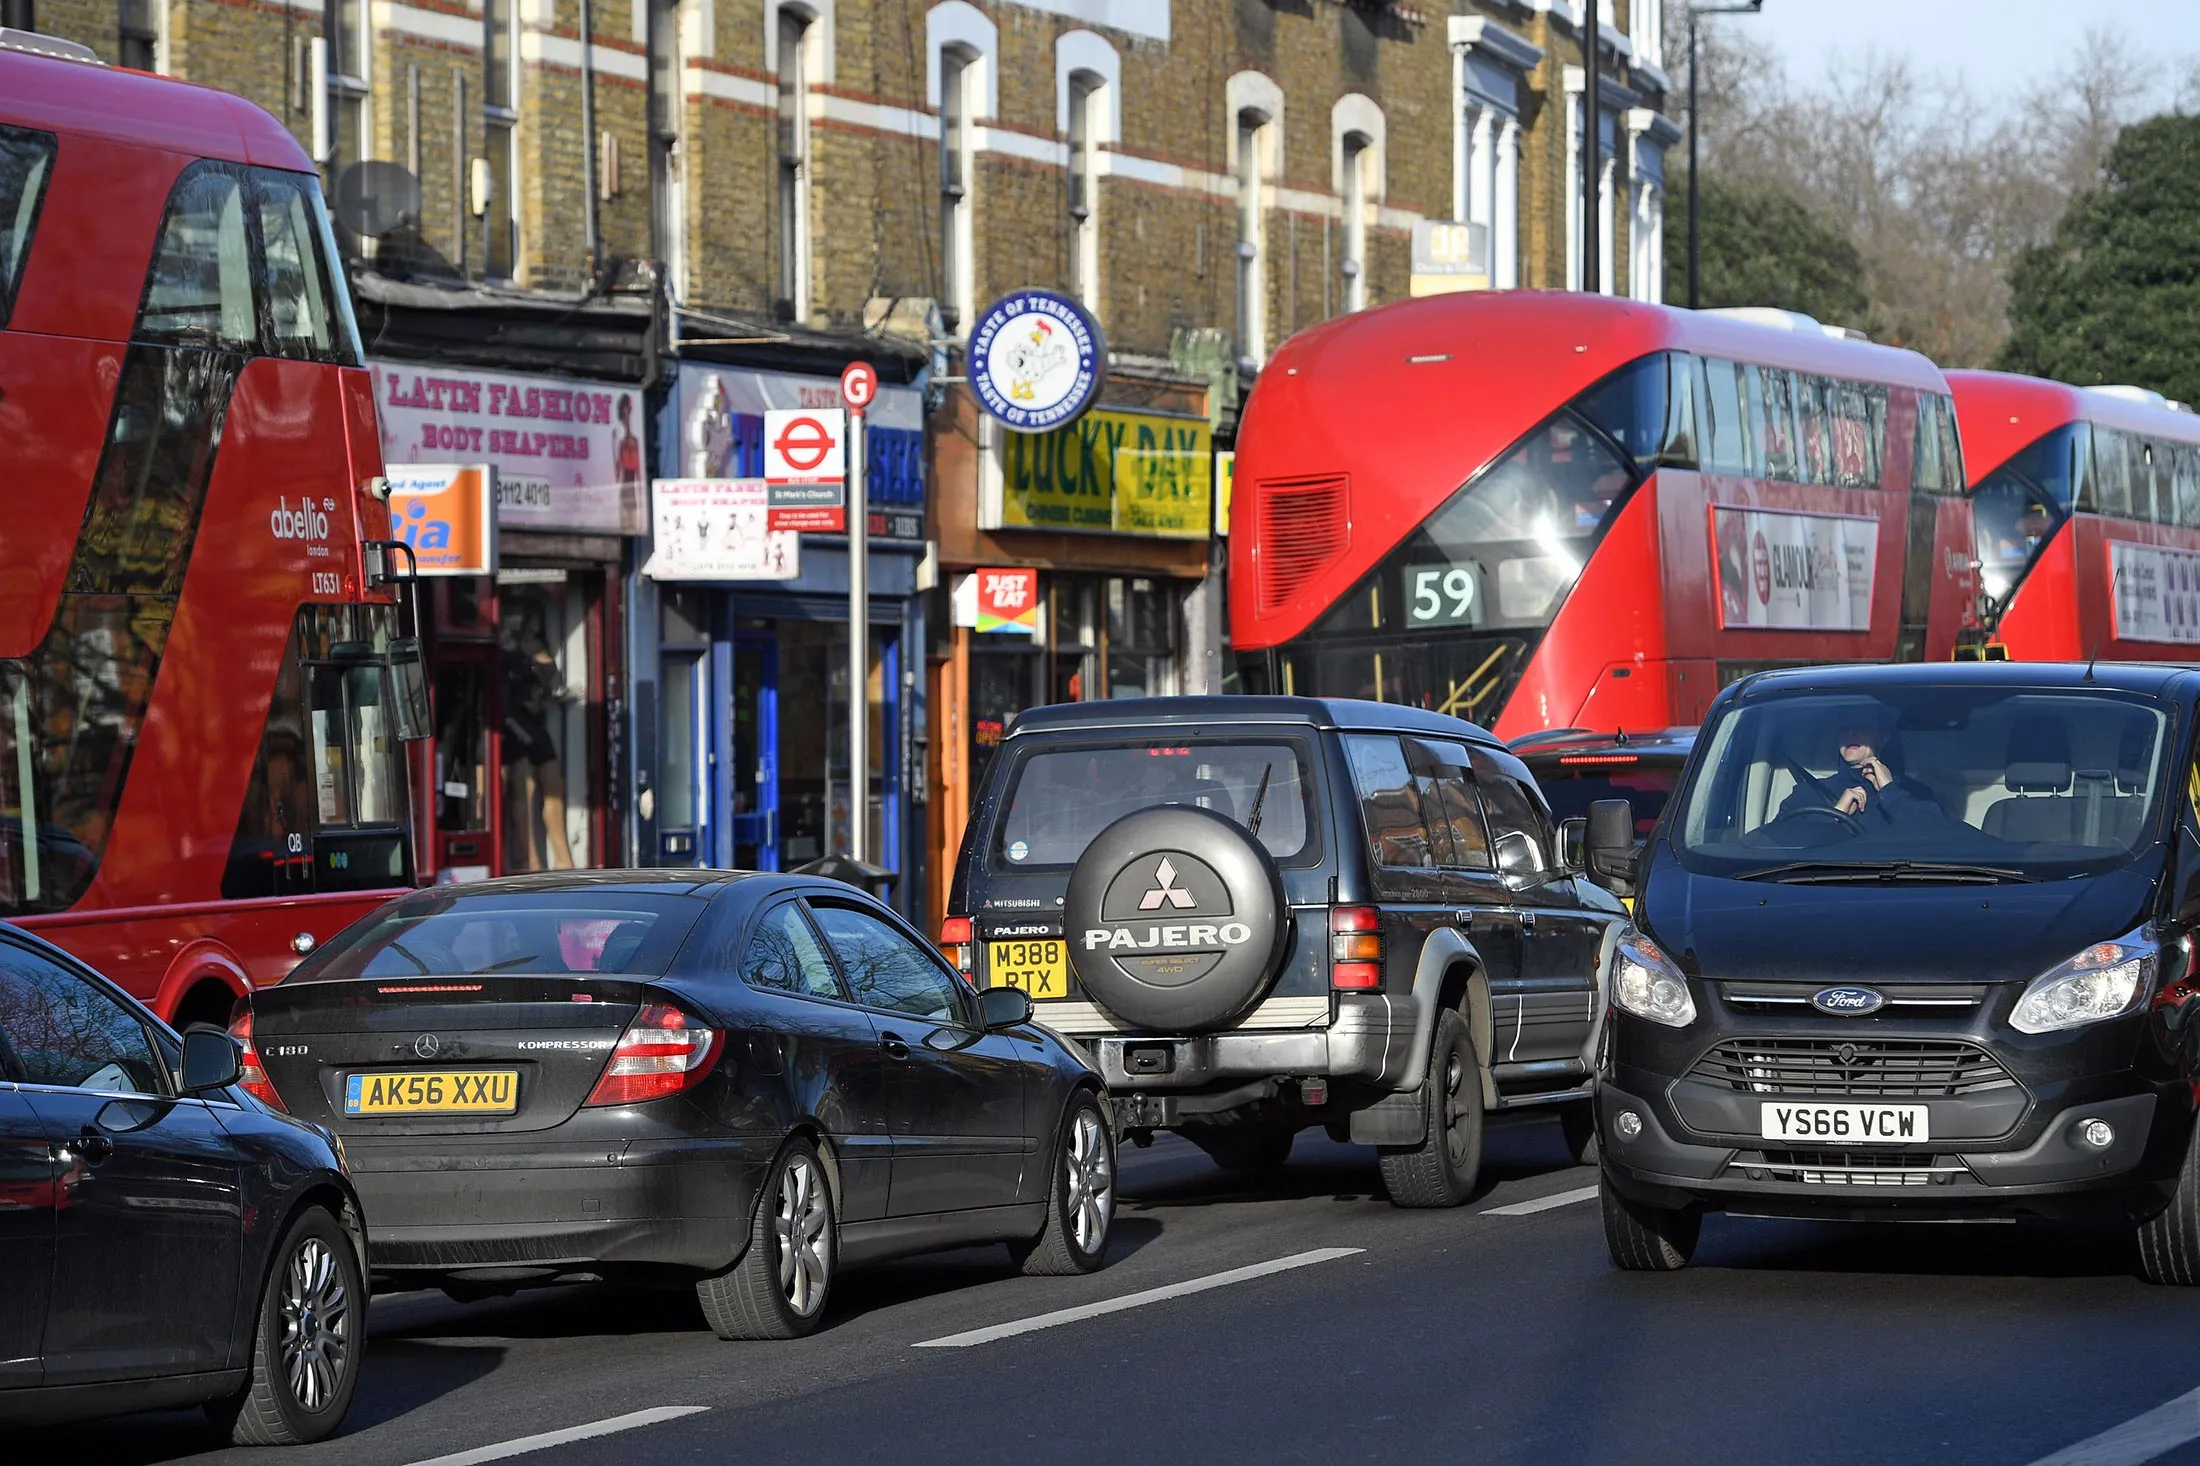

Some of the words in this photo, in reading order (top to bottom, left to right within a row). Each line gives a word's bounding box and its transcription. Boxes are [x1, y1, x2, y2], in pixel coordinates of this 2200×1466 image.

[974, 310, 1007, 356] TASTE
[1005, 298, 1025, 316] OF
[1028, 297, 1093, 355] TENNESSEE
[844, 368, 868, 405] G
[976, 371, 1009, 416] TASTE
[1006, 409, 1027, 424] OF
[1028, 371, 1092, 424] TENNESSEE
[387, 374, 481, 413] LATIN
[487, 383, 612, 424] FASHION
[421, 423, 483, 452] BODY
[489, 427, 589, 460] SHAPERS
[1014, 418, 1126, 497] LUCKY
[1137, 424, 1198, 498] DAY
[411, 480, 446, 491] Agent
[524, 482, 550, 506] 4018
[806, 489, 835, 500] Church
[271, 495, 329, 541] abellio
[307, 545, 329, 557] london
[312, 573, 340, 594] LT631
[984, 575, 1028, 594] JUST
[1412, 569, 1474, 620] 59
[993, 590, 1028, 608] EAT
[288, 833, 302, 853] QB
[994, 899, 1040, 908] MITSUBISHI
[994, 926, 1049, 936] PAJERO
[1085, 922, 1251, 950] PAJERO
[996, 941, 1059, 967] M388
[1169, 957, 1200, 965] SELECT
[1826, 990, 1866, 1008] Ford
[518, 1040, 607, 1050] KOMPRESSOR
[368, 1076, 444, 1106] AK56
[452, 1075, 510, 1104] XXU
[348, 1099, 359, 1107] GB
[1776, 1108, 1849, 1136] YS66
[1860, 1110, 1915, 1137] VCW
